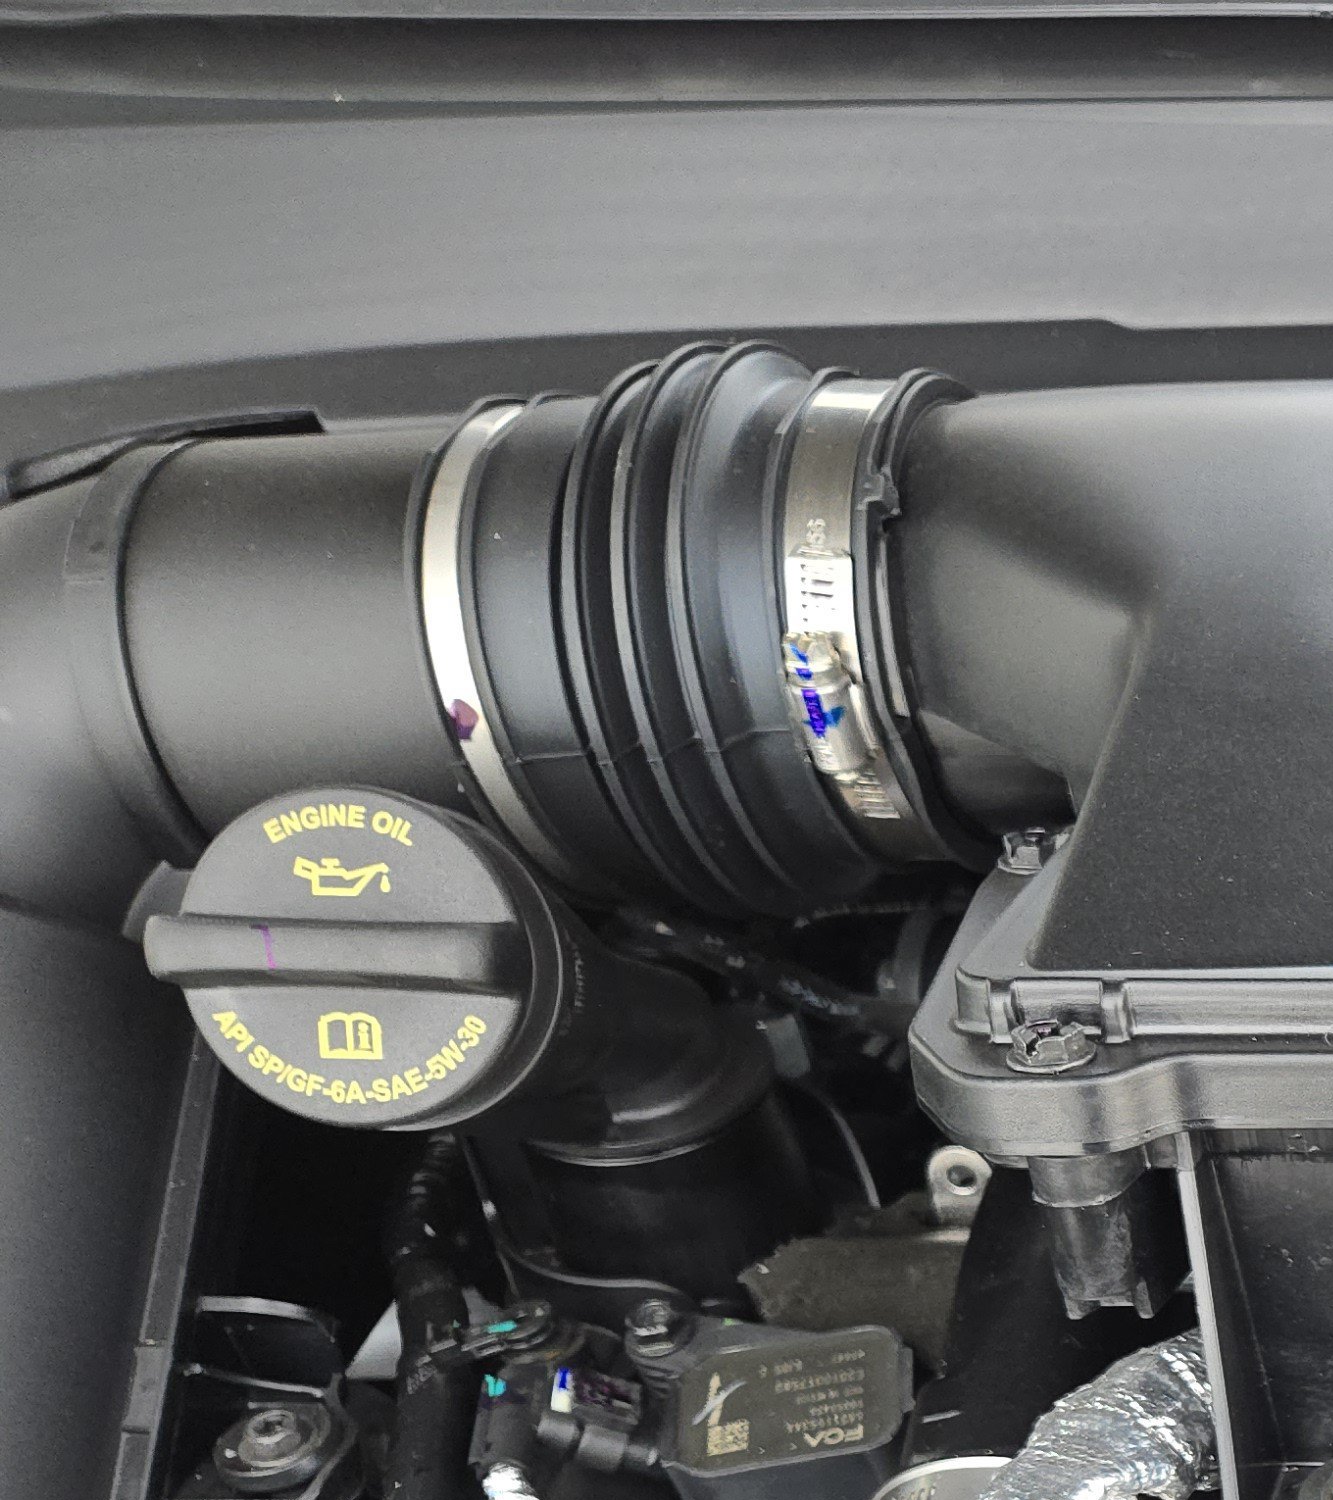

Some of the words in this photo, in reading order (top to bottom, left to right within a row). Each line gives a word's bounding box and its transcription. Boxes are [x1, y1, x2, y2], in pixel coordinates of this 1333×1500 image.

[262, 804, 366, 843] ENGINE
[372, 811, 413, 846] OIL
[212, 1011, 254, 1053] API
[248, 1015, 487, 1104] SP/GF-6A-SAE-5W-30
[804, 1423, 864, 1447] FCA
